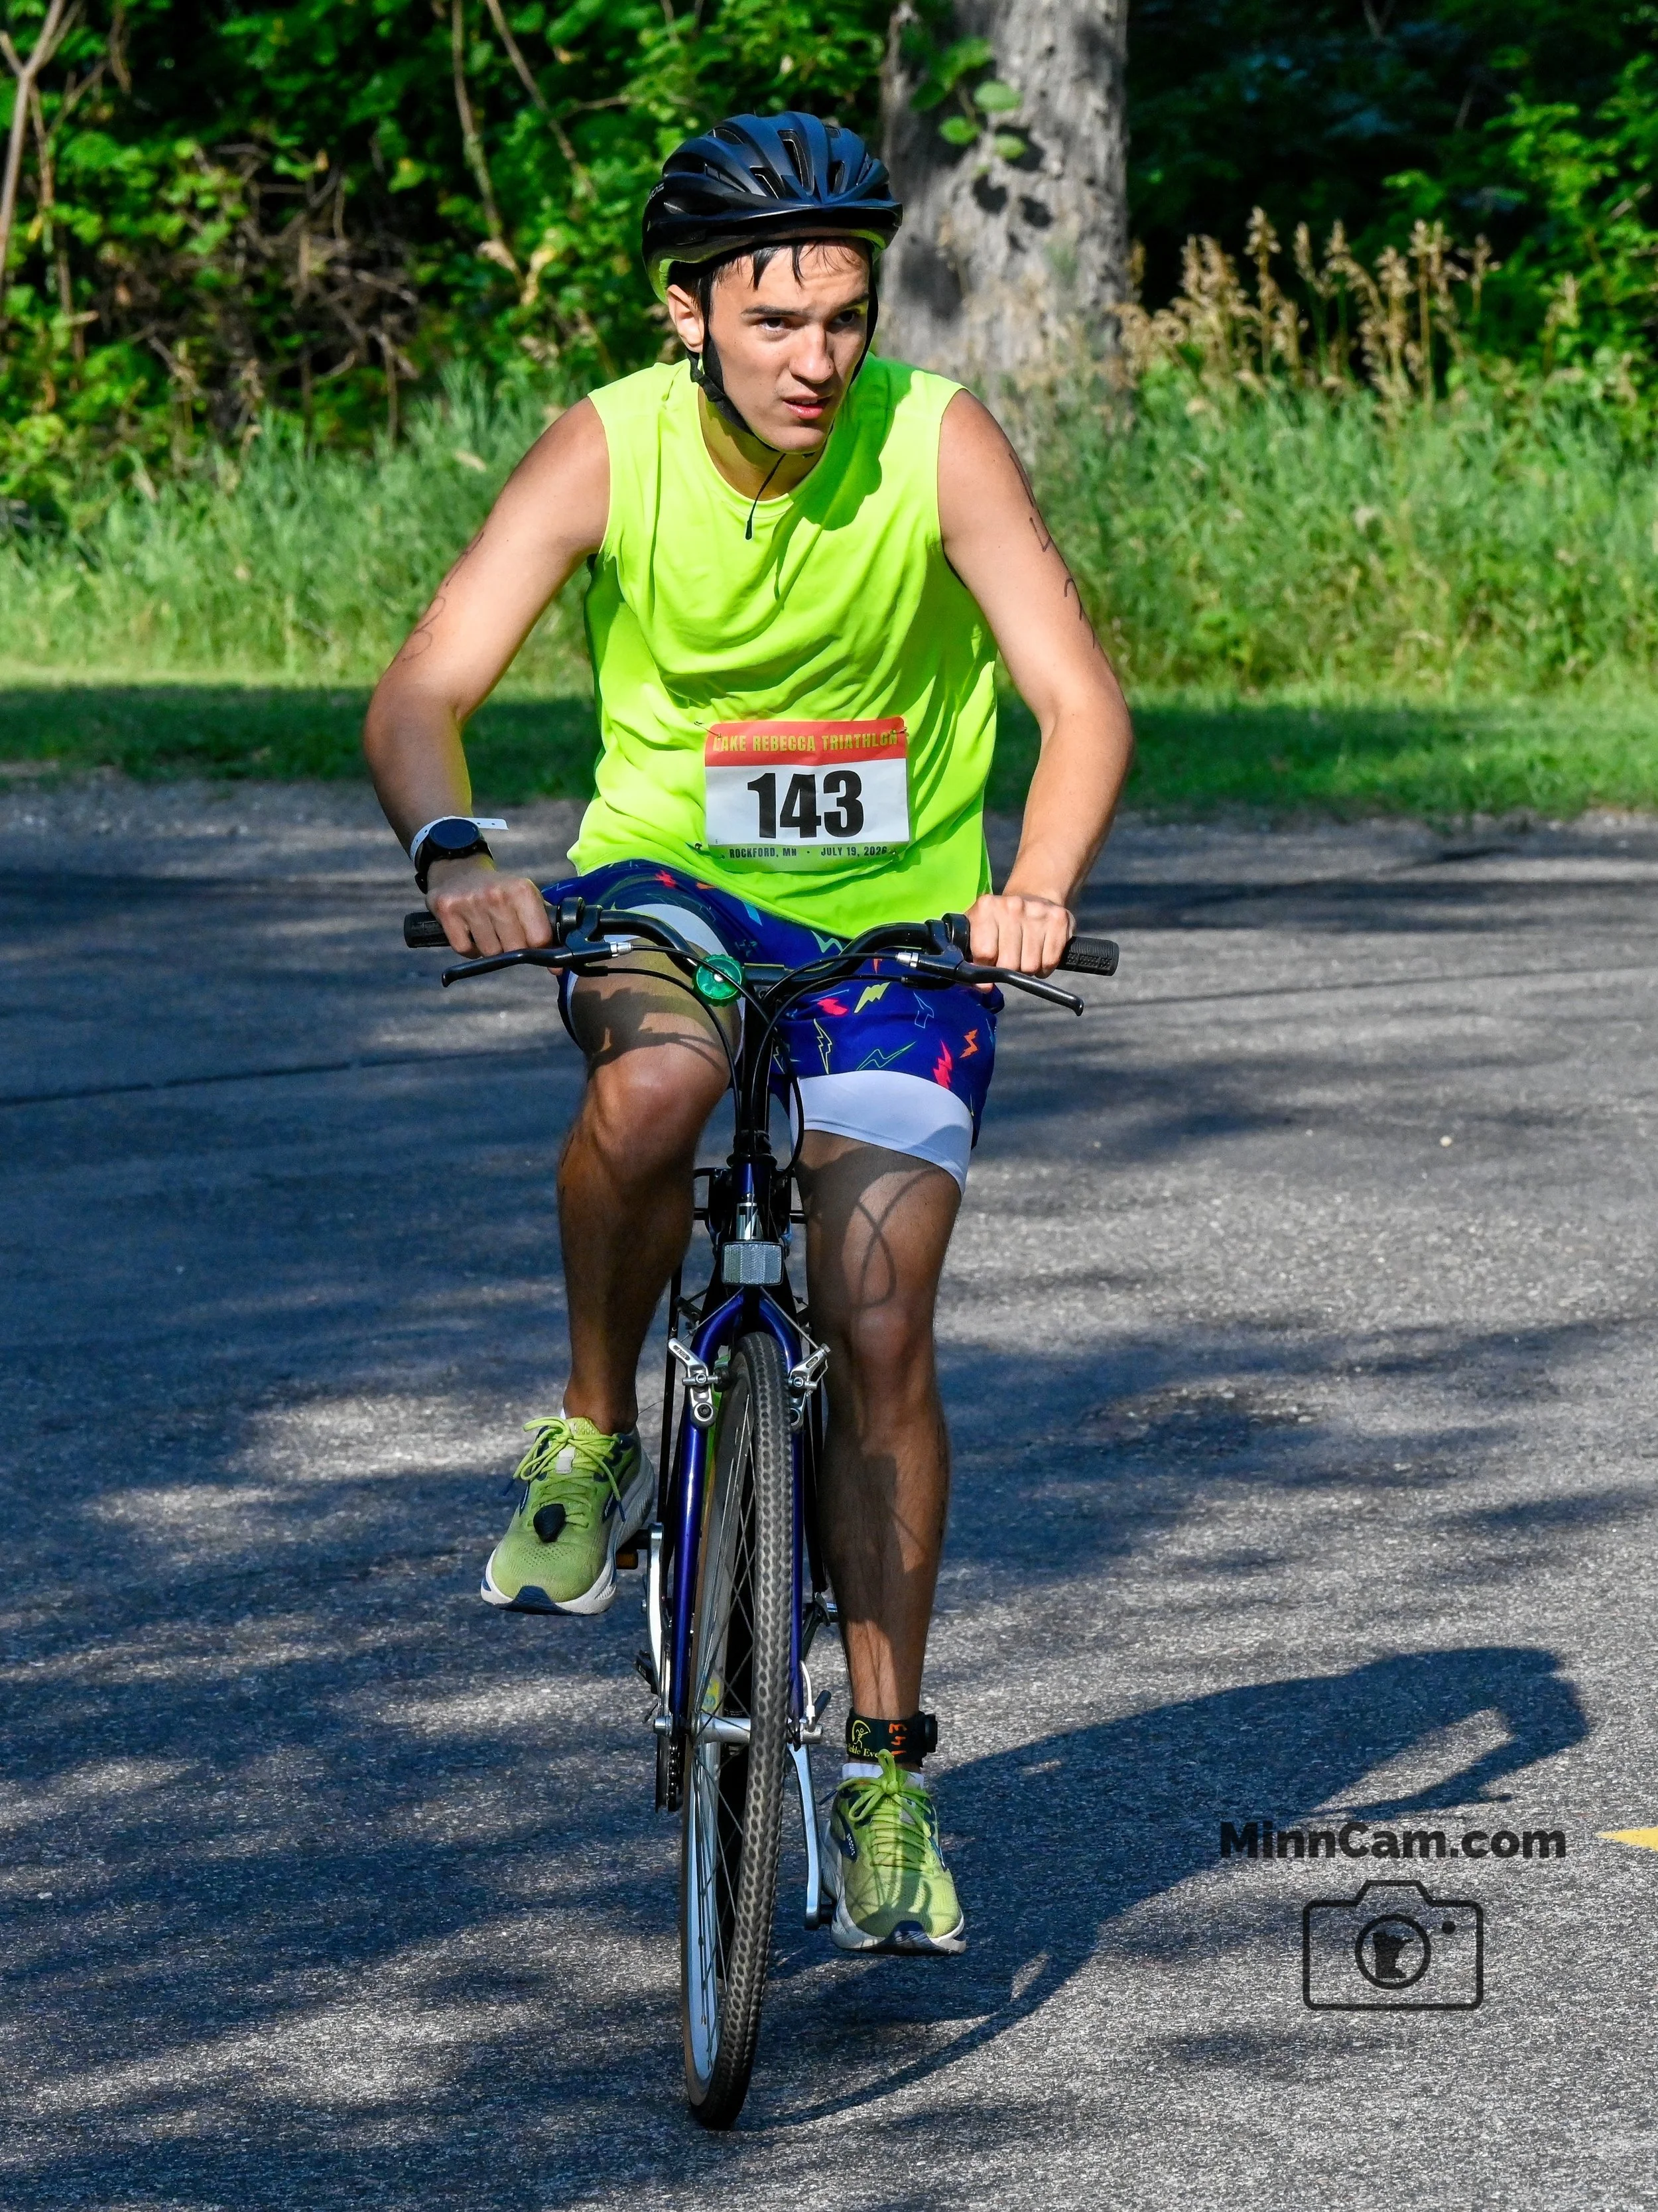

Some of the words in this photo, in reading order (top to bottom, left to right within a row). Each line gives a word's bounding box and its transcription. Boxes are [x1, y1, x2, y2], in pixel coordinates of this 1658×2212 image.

[712, 735, 746, 751] LAKE
[753, 736, 816, 751] REBECCA
[822, 732, 897, 751] TRIATHLON
[747, 769, 864, 839] 143
[730, 848, 779, 858] ROCKFORD,
[783, 848, 797, 856] MN
[820, 846, 842, 856] JULY
[846, 846, 860, 857] 19,
[863, 846, 887, 856] 2026
